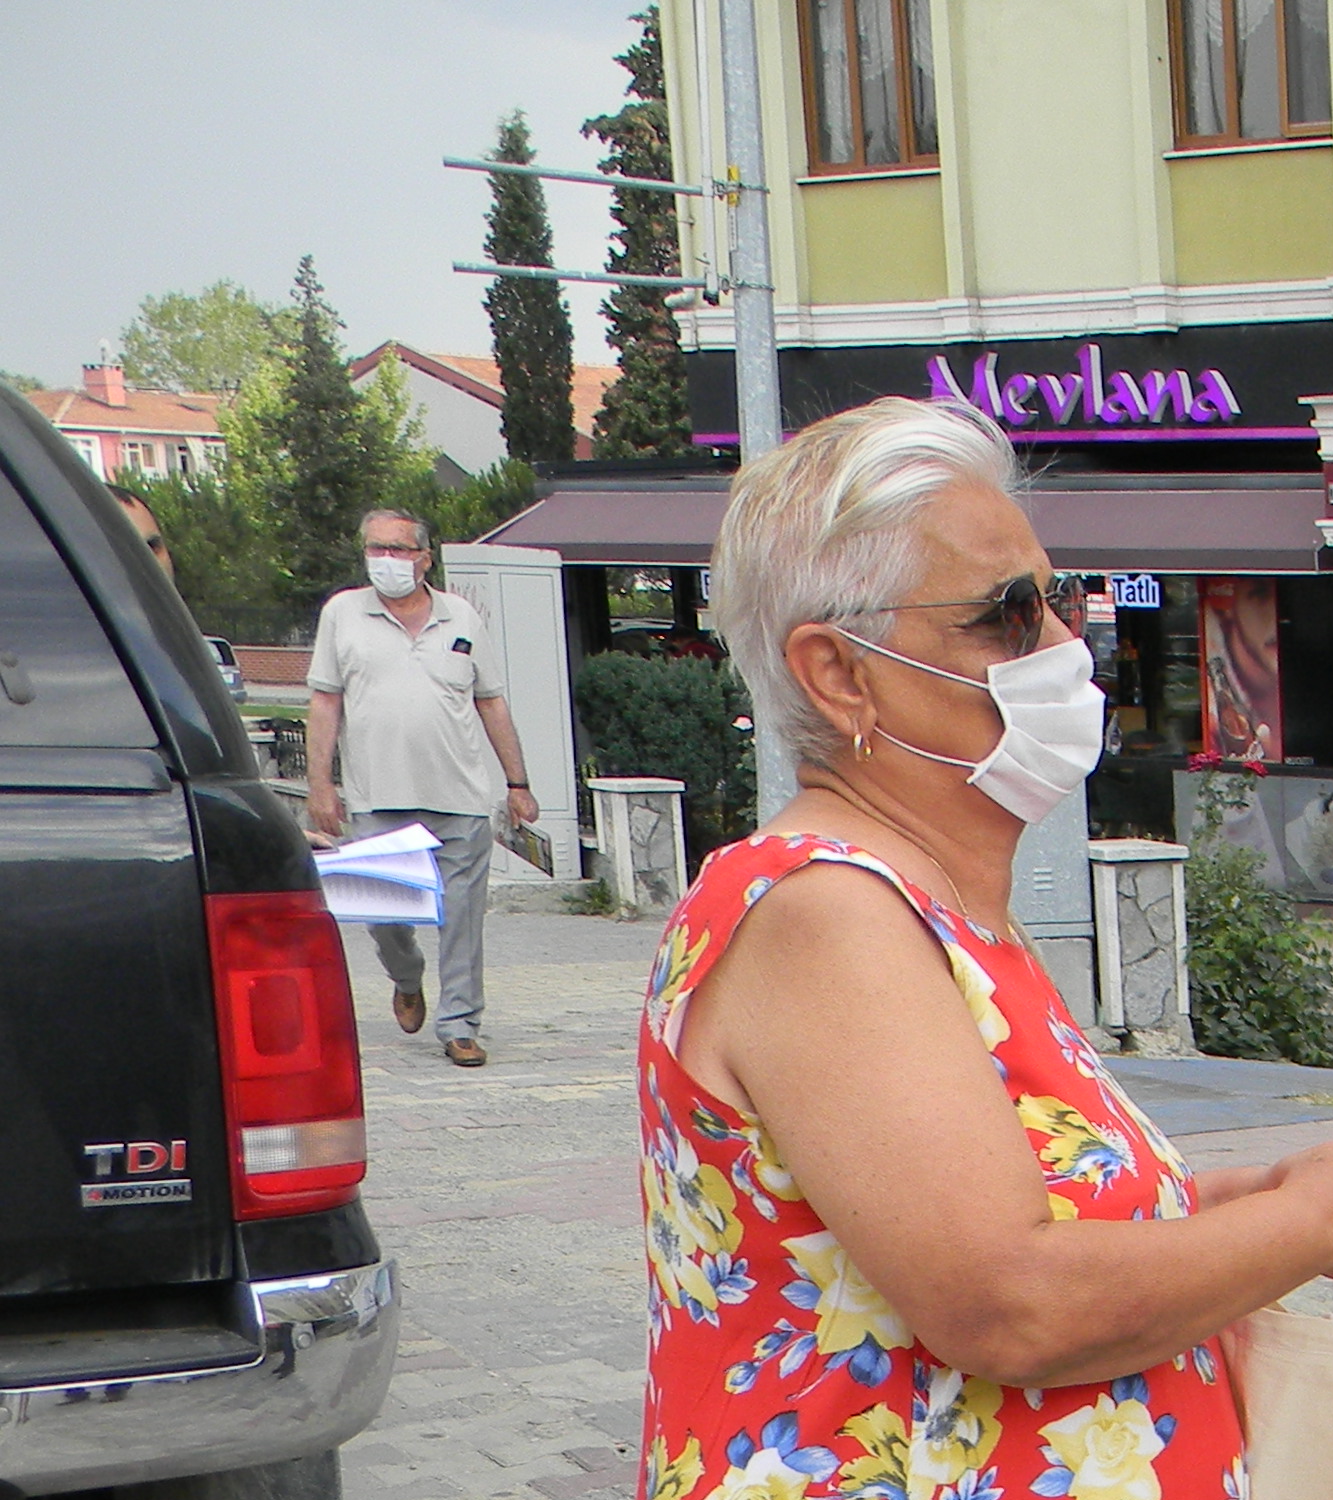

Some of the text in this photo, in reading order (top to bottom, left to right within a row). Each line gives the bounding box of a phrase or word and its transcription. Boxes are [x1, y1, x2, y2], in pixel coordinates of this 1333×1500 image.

[926, 343, 1242, 426] Mevlana
[1112, 577, 1160, 605] Tatlı
[84, 1139, 187, 1176] TDI
